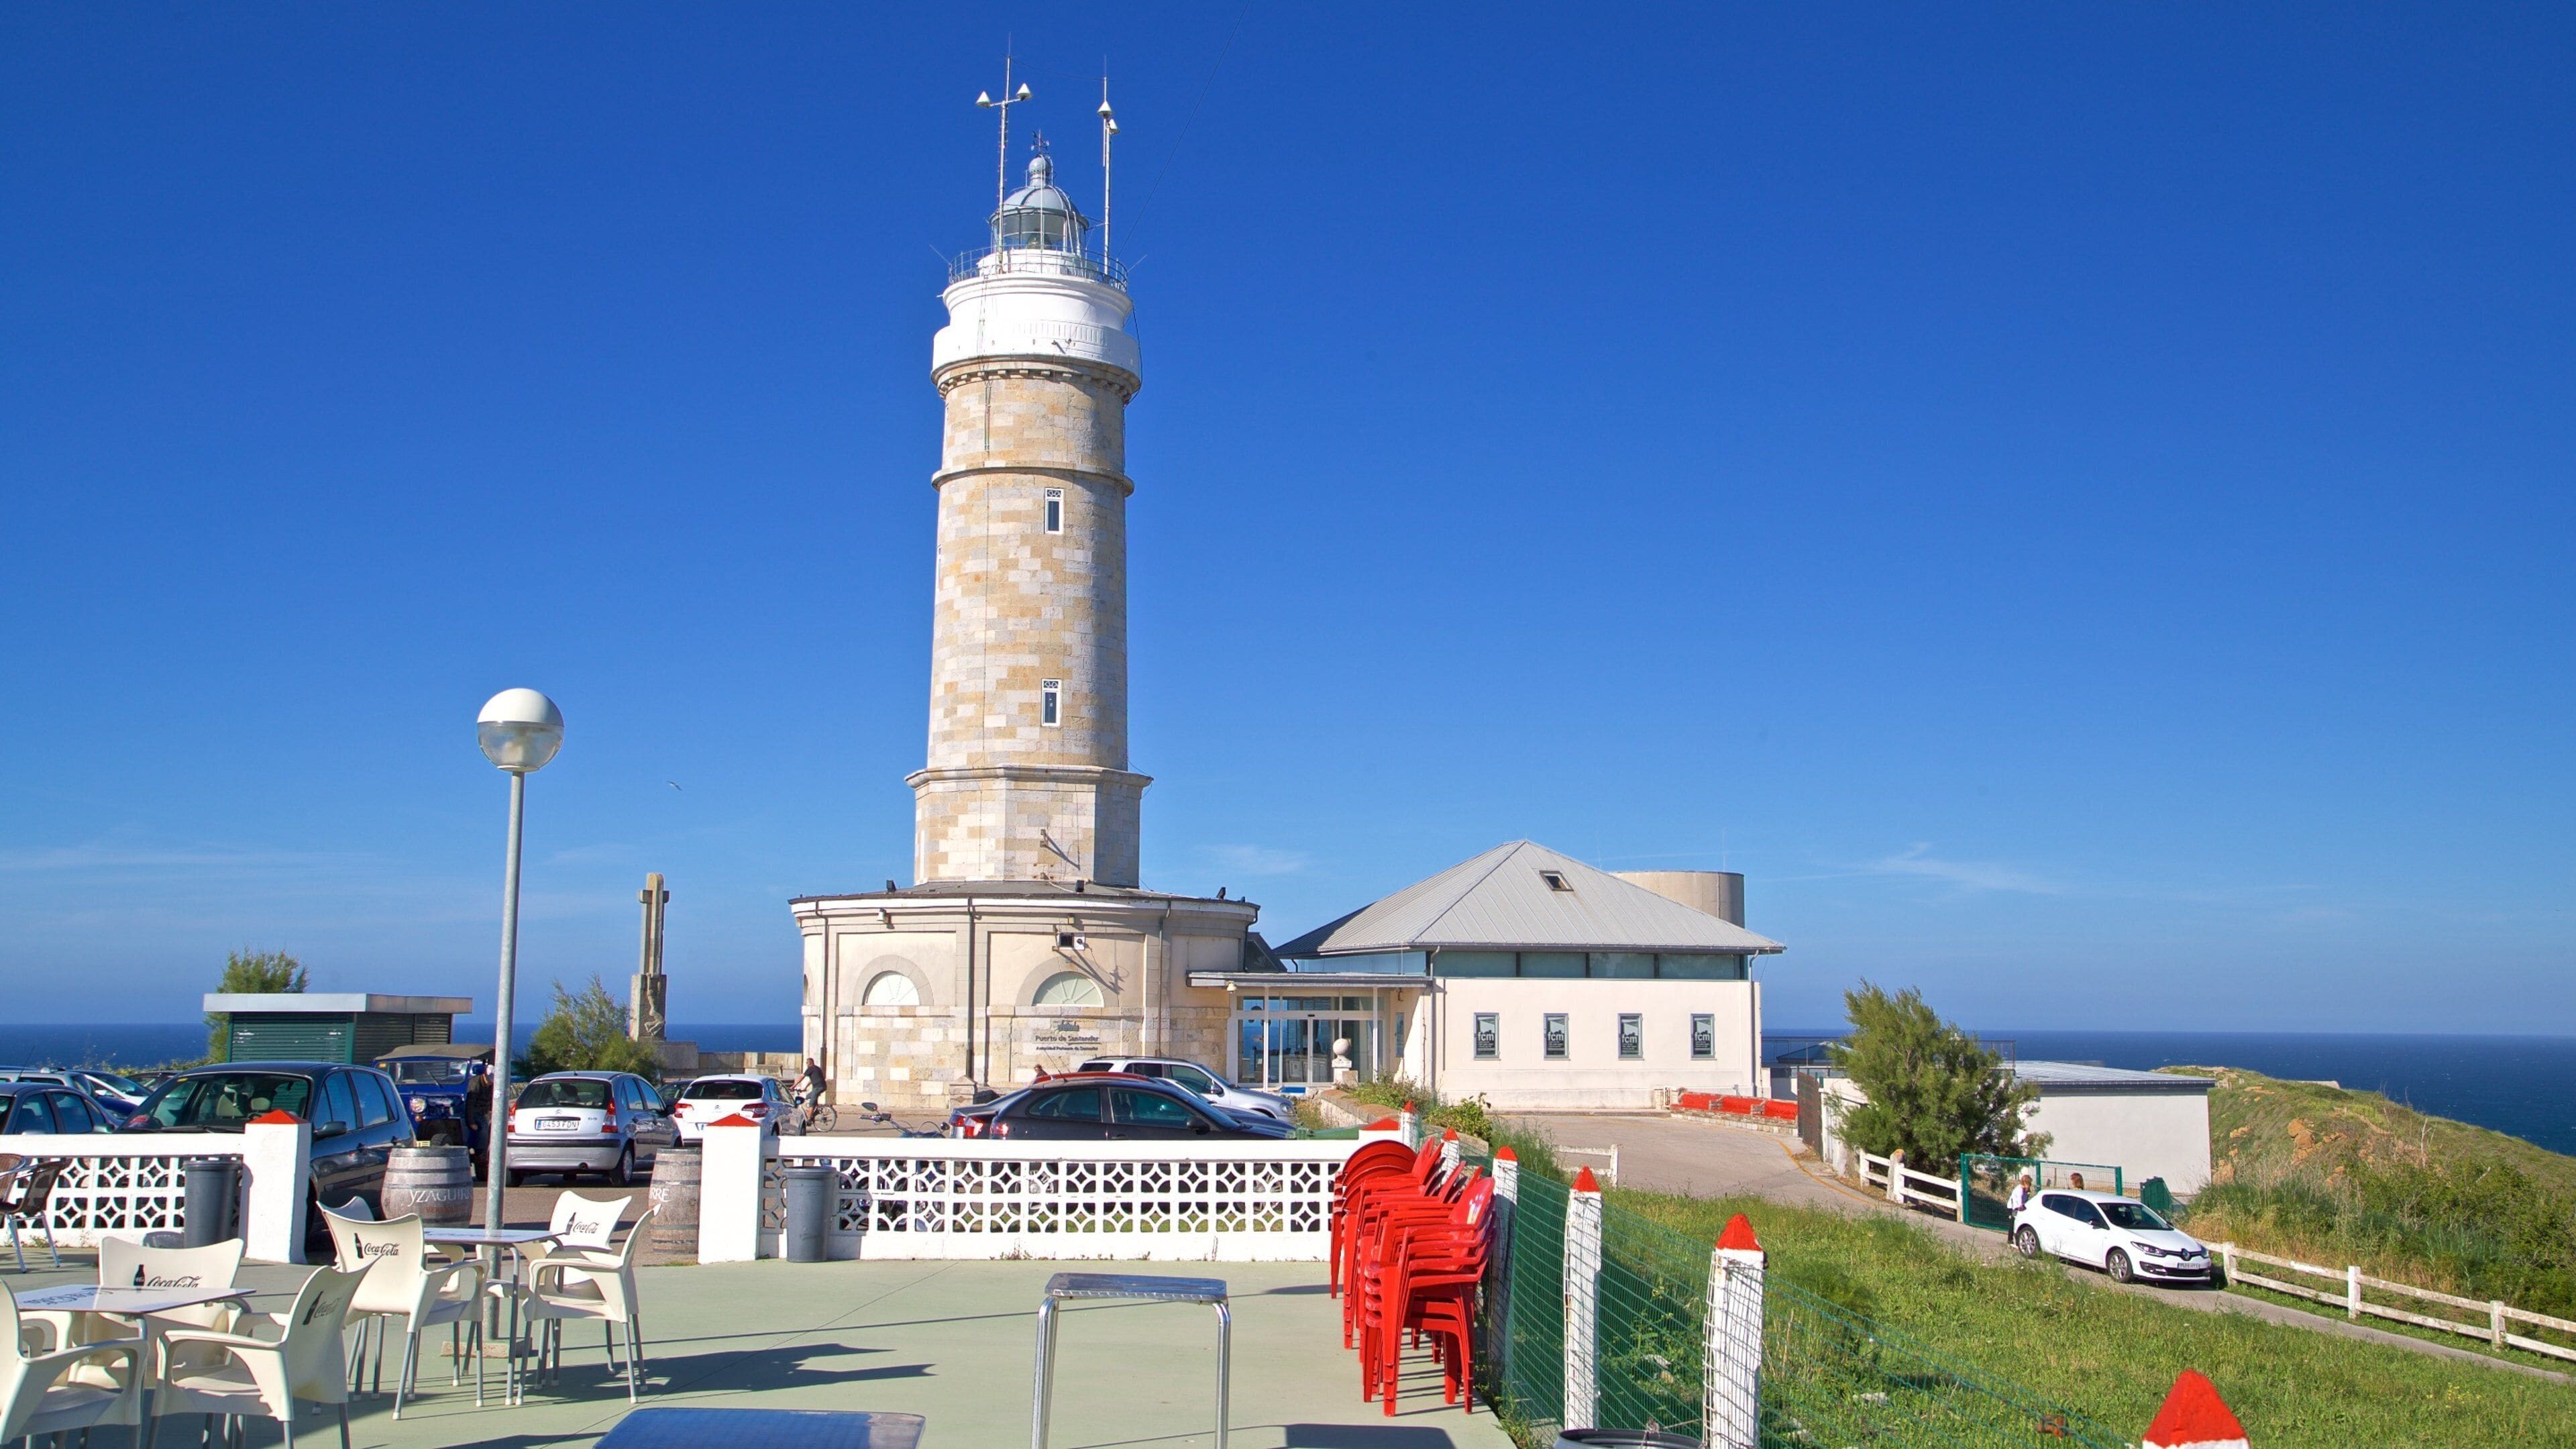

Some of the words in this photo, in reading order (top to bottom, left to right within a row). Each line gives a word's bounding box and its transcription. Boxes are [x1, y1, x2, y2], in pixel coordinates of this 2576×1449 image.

[1478, 1032, 1494, 1041] fcm
[1548, 1032, 1564, 1041] fcm
[1621, 1034, 1637, 1043] fcm
[1695, 1032, 1710, 1041] fcm
[364, 1242, 400, 1256] Coca-Cola
